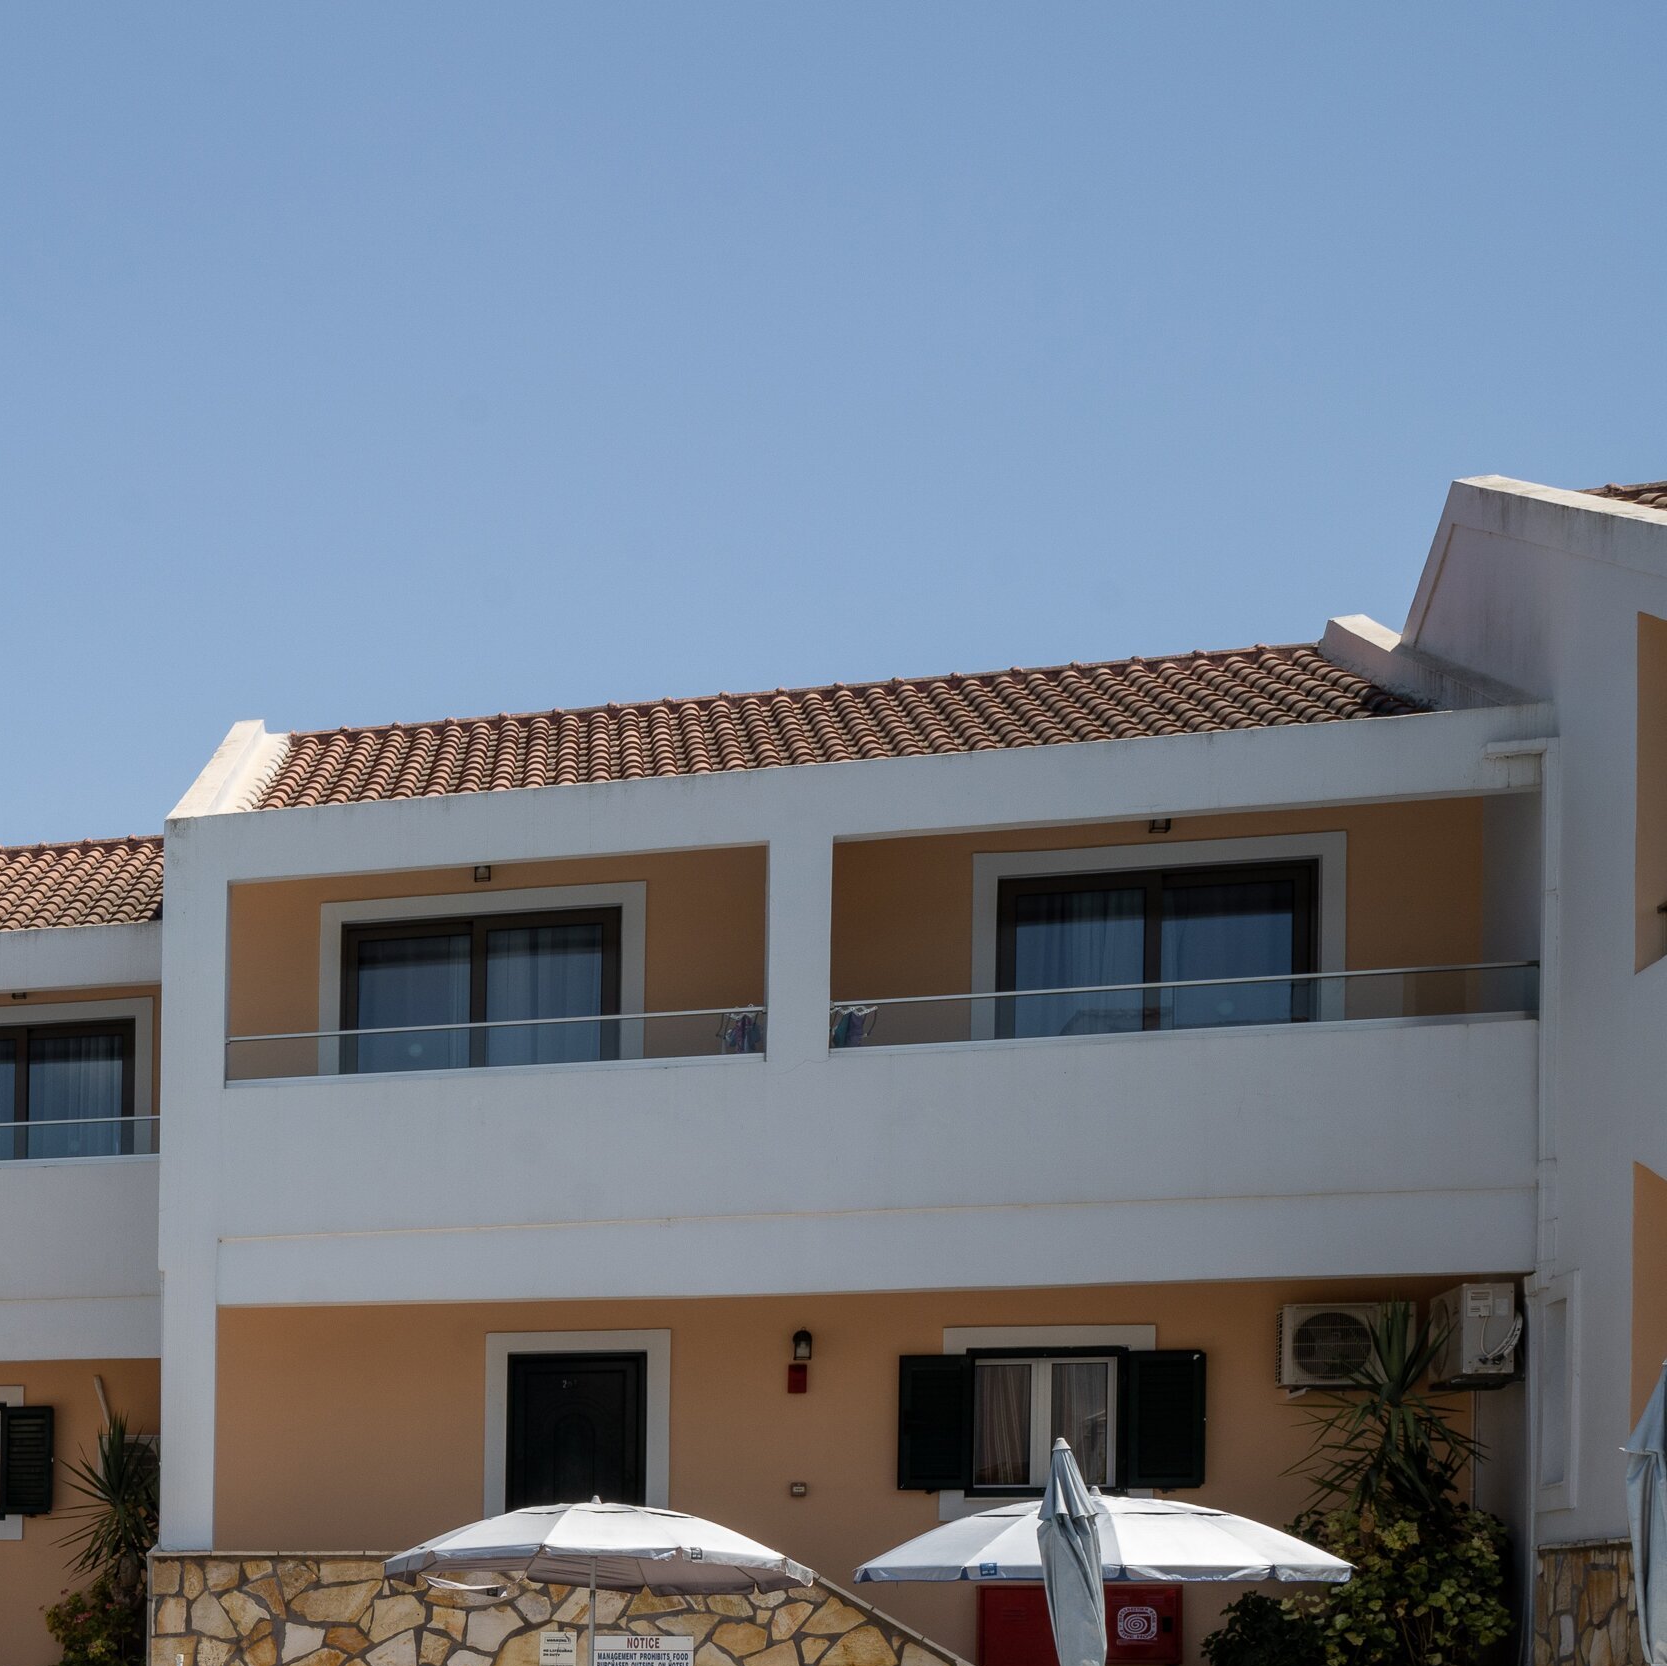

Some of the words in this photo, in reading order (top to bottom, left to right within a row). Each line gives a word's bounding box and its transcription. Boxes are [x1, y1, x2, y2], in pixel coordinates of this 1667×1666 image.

[627, 1637, 660, 1649] NOTICE
[597, 1652, 637, 1660] MANAGEMENT
[672, 1652, 689, 1660] FOOD
